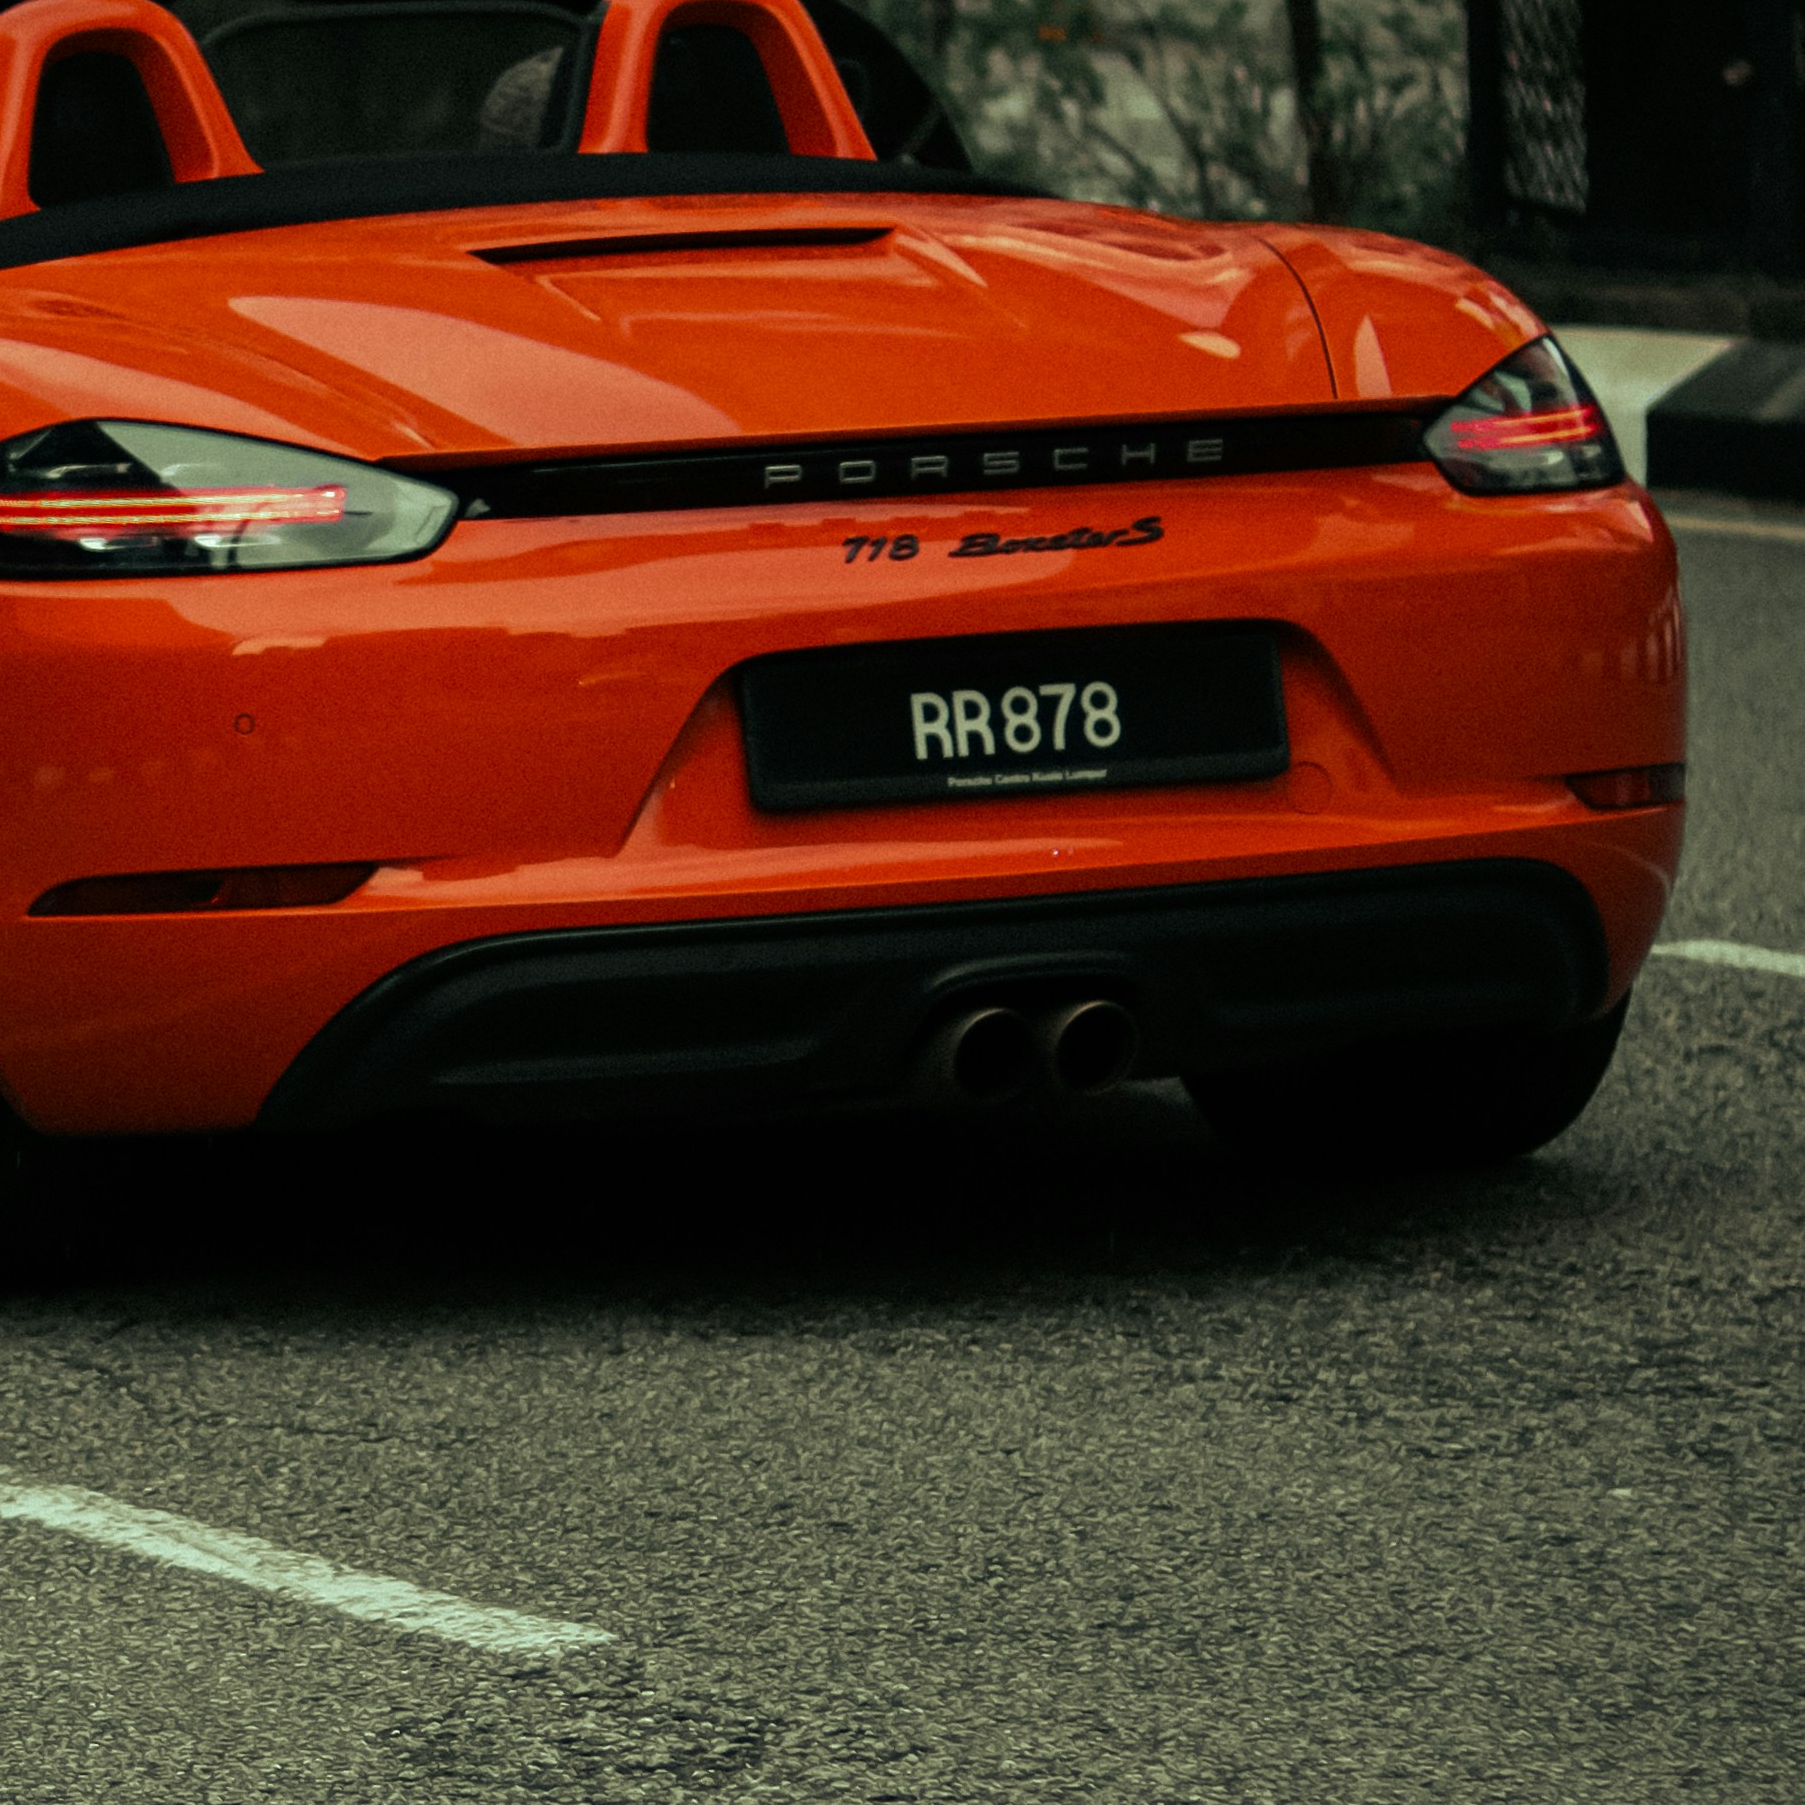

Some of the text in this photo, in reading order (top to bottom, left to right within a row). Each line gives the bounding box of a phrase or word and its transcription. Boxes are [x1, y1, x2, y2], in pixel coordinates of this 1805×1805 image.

[764, 438, 1224, 489] PORSCHE
[842, 533, 921, 564] 718
[910, 681, 1122, 760] RR878
